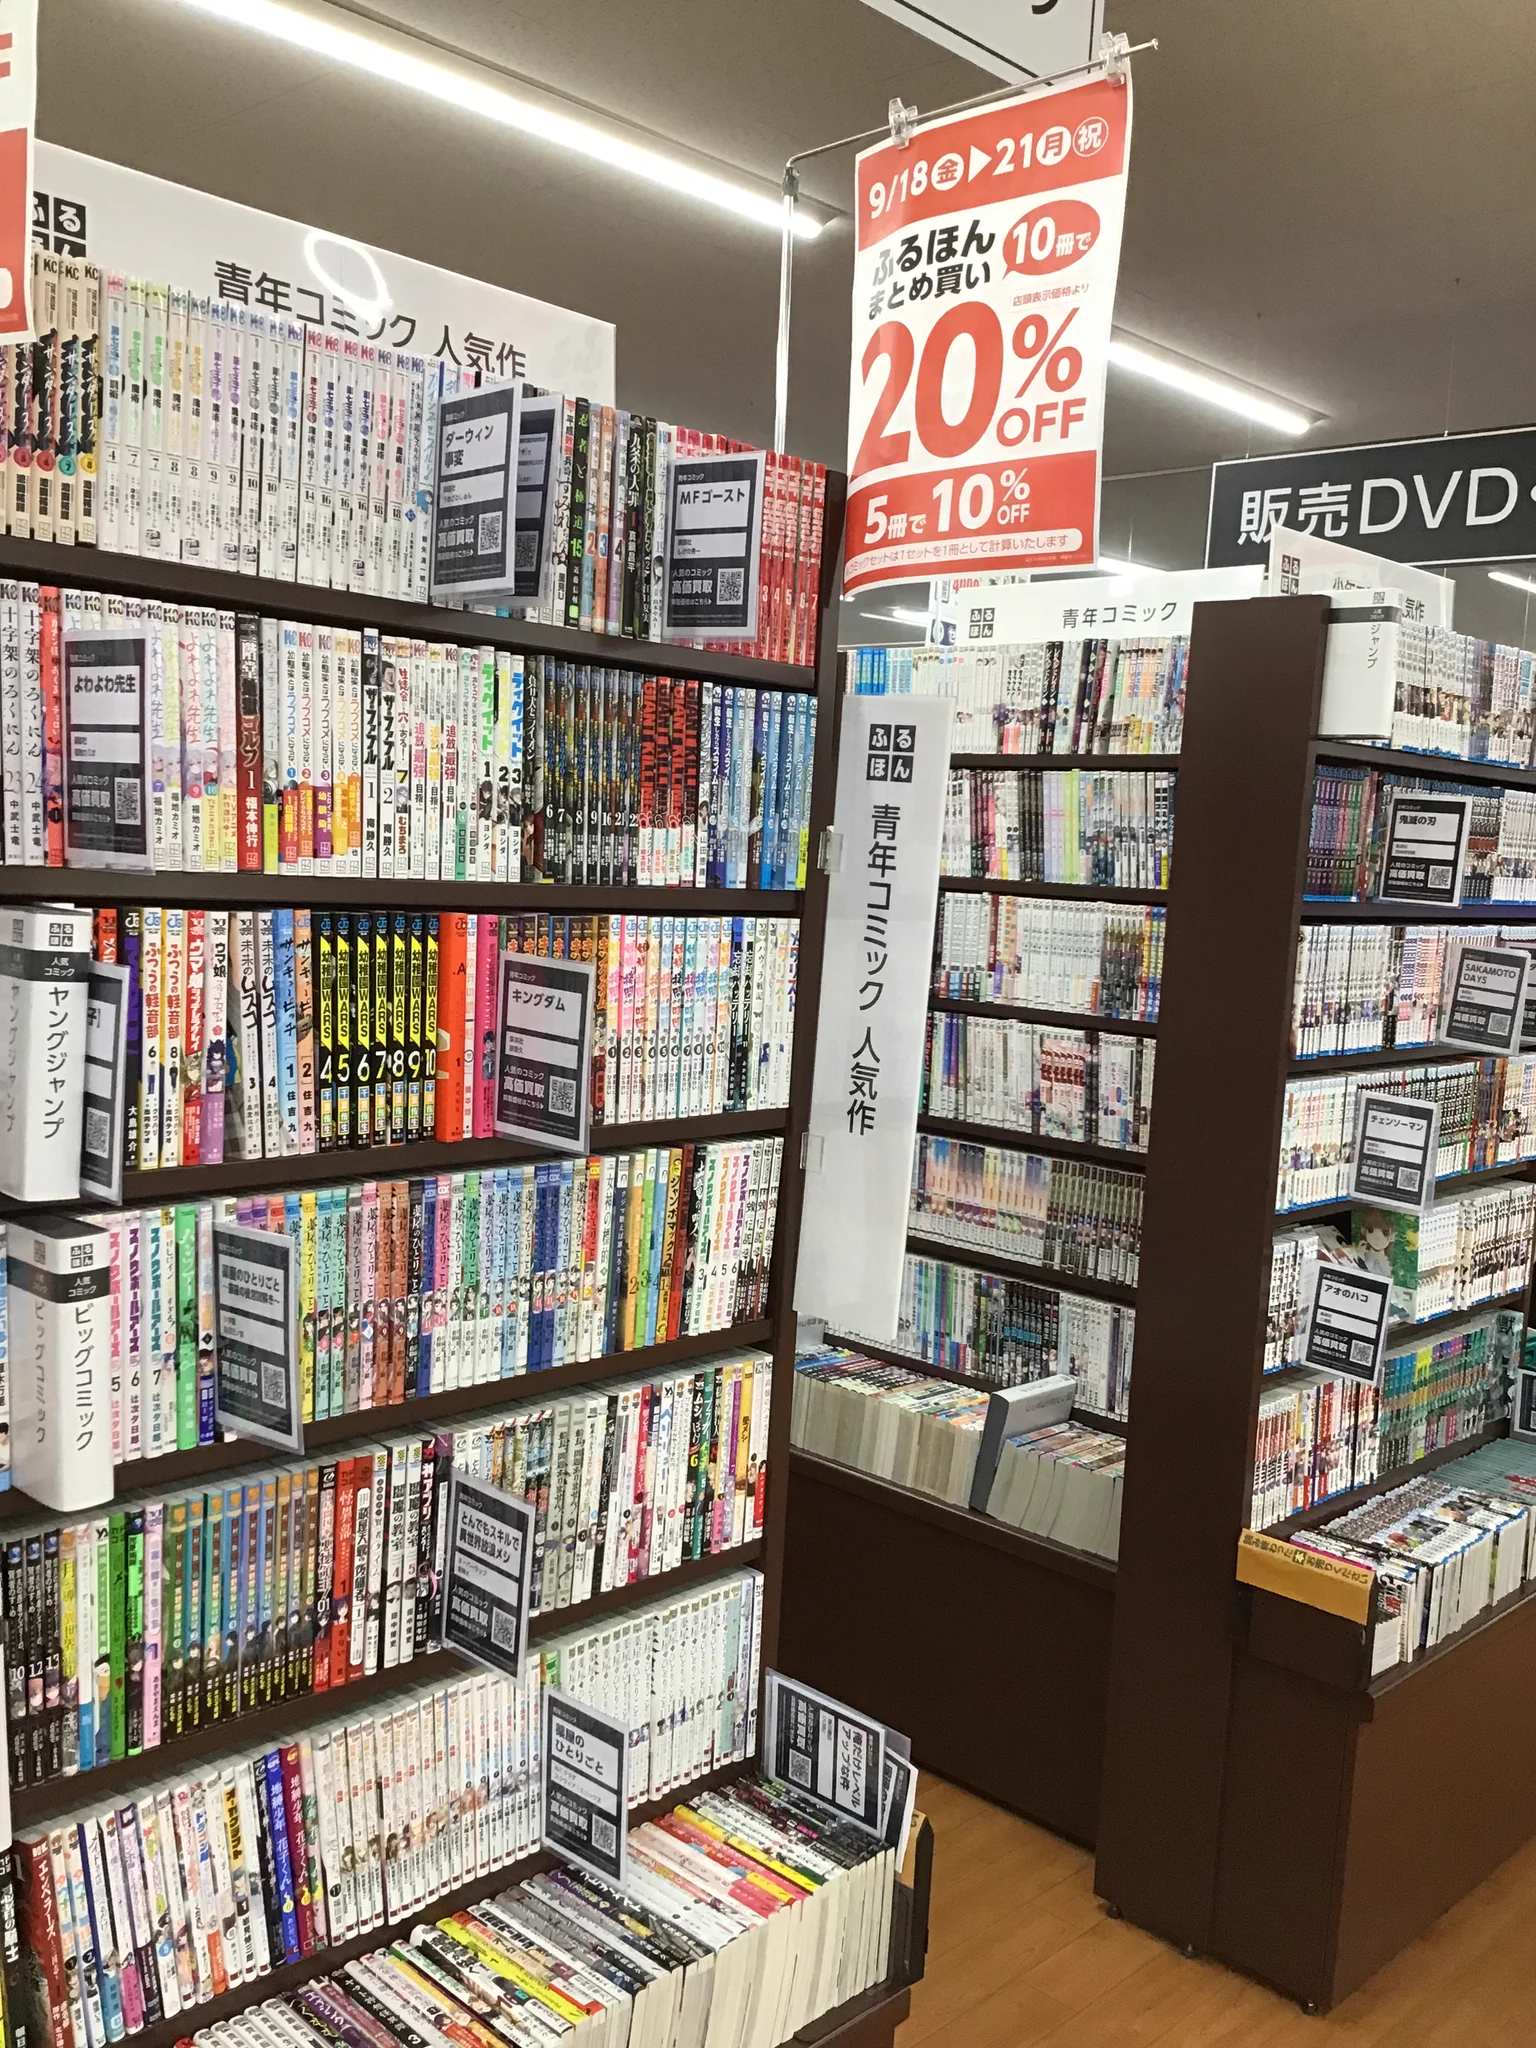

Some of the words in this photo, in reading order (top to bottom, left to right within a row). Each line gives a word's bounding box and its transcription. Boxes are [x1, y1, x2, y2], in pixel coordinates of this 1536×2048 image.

[872, 219, 996, 287] ふるほん
[1011, 217, 1092, 264] 10冊で
[214, 260, 416, 348] 青年コミック
[867, 260, 991, 320] まとめ買い
[1012, 283, 1090, 308] 店頭表示価格より
[434, 324, 527, 379] 人気作
[446, 425, 494, 448] ダーウィン
[996, 398, 1087, 447] OFF
[444, 450, 464, 469] 事変
[574, 414, 588, 530] 忍者と極道
[680, 488, 745, 505] MFゴースト
[863, 493, 927, 547] 5冊で
[996, 502, 1030, 526] OFF
[438, 528, 474, 548] 高価買取
[571, 537, 583, 558] 15
[587, 532, 595, 555] 2
[600, 533, 607, 557] 3
[672, 580, 713, 594] 高価買取
[673, 568, 712, 577] 人気のコミック
[970, 607, 995, 623] ふる
[1062, 601, 1177, 629] 青年コミック
[1401, 597, 1425, 621] 気作
[969, 623, 993, 638] ほん
[1368, 623, 1381, 668] ジャンプ
[2, 606, 19, 757] 十字架のろくにん
[24, 608, 40, 758] 十字架のろくにん
[74, 674, 136, 693] よわよわ先生
[186, 631, 200, 744] よわよわ先生
[203, 632, 217, 744] よわよわ先生
[869, 723, 916, 750] ふる
[866, 753, 914, 783] ほん
[245, 796, 258, 847] 福本伸行
[546, 804, 553, 819] 6
[1399, 815, 1437, 826] 鬼滅の刃
[367, 818, 376, 851] 南勝久
[383, 824, 392, 857] 南勝久
[398, 816, 407, 855] むちまろ
[1389, 869, 1425, 880] 高価買取
[858, 803, 901, 1012] 青年コミック
[50, 923, 73, 934] ふる
[50, 935, 73, 947] ほん
[44, 966, 76, 977] コミック
[52, 956, 69, 966] 人気
[213, 943, 227, 978] ウマ娘
[1465, 963, 1516, 979] SAKAMOTO
[145, 942, 161, 1039] ふつうの軽音部
[167, 943, 182, 1039] ふつうの軽音部
[283, 938, 296, 1038] サンキューピッチ
[299, 939, 312, 1038] サンキューピッチ
[376, 947, 387, 1035] 幼稚園WARS
[1464, 973, 1487, 984] DAYS
[321, 950, 331, 1039] 幼稚園WARS
[338, 950, 349, 1038] 幼稚園WARS
[358, 950, 369, 1038] 幼稚園WARS
[512, 989, 566, 1012] キングダム
[43, 987, 69, 1139] ヤングジャンプ
[148, 1046, 156, 1057] 6
[425, 1049, 436, 1075] 10
[337, 1054, 349, 1082] 5
[504, 1065, 544, 1081] 人気のコミック
[846, 1025, 881, 1137] 人気作
[503, 1076, 545, 1098] 高価買取
[287, 1091, 297, 1133] 住吉九
[303, 1090, 313, 1132] 住吉九
[1371, 1115, 1424, 1131] チェンソーマン
[70, 1243, 93, 1256] ふる
[70, 1256, 93, 1268] ほん
[68, 1285, 97, 1298] コミック
[74, 1276, 91, 1287] 人気
[129, 1228, 140, 1352] スノウボールアース
[151, 1227, 161, 1351] スノウボールアース
[222, 1263, 280, 1292] 薬屋のひとりごと
[110, 1228, 121, 1357] スノウボールアース
[1325, 1284, 1369, 1303] アオのハコ
[74, 1302, 96, 1452] ビッグコミック
[111, 1376, 121, 1392] 5
[459, 1527, 511, 1563] 異世界放浪メシ
[461, 1511, 520, 1551] とんでもスキルで
[452, 1596, 489, 1627] 高価買取
[29, 1661, 43, 1677] 12
[555, 1723, 585, 1748] 薬屋の
[555, 1739, 604, 1775] ひとりごと
[840, 1725, 851, 1791] アップな件
[851, 1730, 863, 1809] 俺だけレベル
